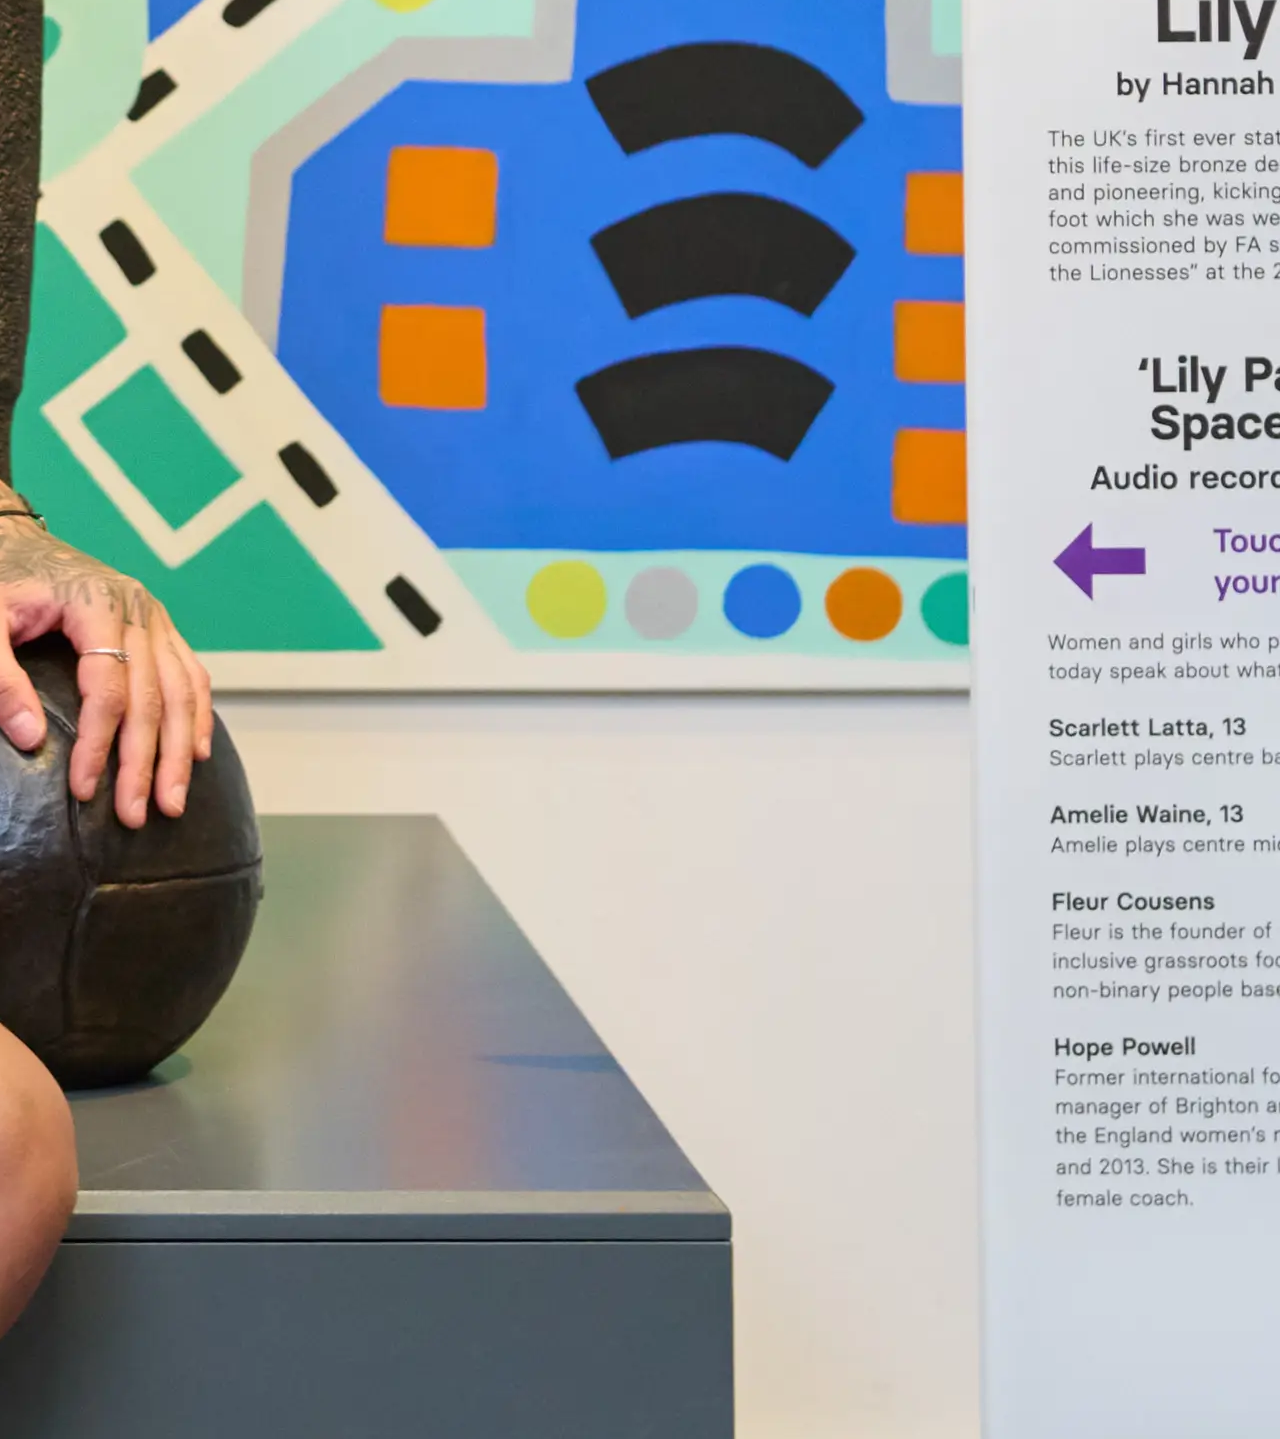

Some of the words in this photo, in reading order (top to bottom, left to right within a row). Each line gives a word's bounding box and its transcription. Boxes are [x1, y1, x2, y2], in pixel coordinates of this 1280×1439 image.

[1116, 70, 1152, 104] by
[1162, 69, 1275, 97] Hannah
[1047, 129, 1086, 148] The
[1144, 127, 1186, 147] first
[1192, 132, 1237, 147] ever
[1047, 155, 1085, 175] this
[1092, 155, 1171, 175] life-size
[1178, 154, 1248, 174] bronze
[1254, 154, 1280, 173] de
[1048, 182, 1085, 202] and
[1093, 182, 1205, 205] pioneering,
[1047, 209, 1089, 228] foot
[1095, 208, 1155, 228] which
[1162, 208, 1199, 228] she
[1205, 212, 1245, 227] was
[1251, 212, 1280, 227] we
[1048, 235, 1196, 255] commissioned
[1203, 235, 1228, 257] by
[1235, 235, 1262, 254] FA
[1048, 263, 1082, 282] the
[1205, 264, 1225, 281] at
[1232, 261, 1266, 281] the
[1244, 355, 1280, 394] P
[1089, 462, 1179, 491] Audio
[1047, 633, 1122, 651] Women
[1128, 632, 1165, 651] and
[1171, 631, 1213, 655] girls
[1219, 631, 1261, 650] who
[1048, 662, 1103, 684] today
[1109, 661, 1168, 684] speak
[1173, 661, 1230, 679] about
[1048, 716, 1141, 740] Scarlett
[1148, 717, 1215, 740] Latta,
[1221, 716, 1247, 737] 13
[1049, 748, 1127, 767] Scarlett
[1134, 748, 1185, 771] plays
[1191, 750, 1255, 766] centre
[1049, 803, 1129, 825] Amelie
[1135, 803, 1212, 827] Waine,
[1219, 803, 1244, 824] 13
[1050, 835, 1118, 854] Amelie
[1125, 834, 1176, 858] plays
[1182, 837, 1245, 853] centre
[1052, 891, 1110, 912] Fleur
[1116, 891, 1216, 912] Cousens
[1052, 923, 1102, 941] Fleur
[1108, 922, 1124, 941] is
[1131, 922, 1163, 941] the
[1169, 921, 1246, 940] founder
[1253, 920, 1272, 940] of
[1052, 951, 1139, 970] inclusive
[1144, 953, 1249, 974] grassroots
[1053, 980, 1161, 1003] non-binary
[1167, 980, 1234, 1003] people
[1054, 1037, 1115, 1062] Hope
[1122, 1035, 1196, 1057] Powell
[1055, 1068, 1126, 1087] Former
[1133, 1067, 1255, 1086] international
[1055, 1101, 1142, 1120] manager
[1148, 1095, 1168, 1115] of
[1175, 1096, 1259, 1120] Brighton
[1055, 1126, 1087, 1145] the
[1094, 1125, 1173, 1148] England
[1055, 1157, 1092, 1176] and
[1099, 1157, 1150, 1176] 2013.
[1157, 1156, 1195, 1176] She
[1202, 1157, 1218, 1175] is
[1224, 1156, 1270, 1175] their
[1056, 1188, 1123, 1208] female
[1129, 1188, 1194, 1207] coach.
